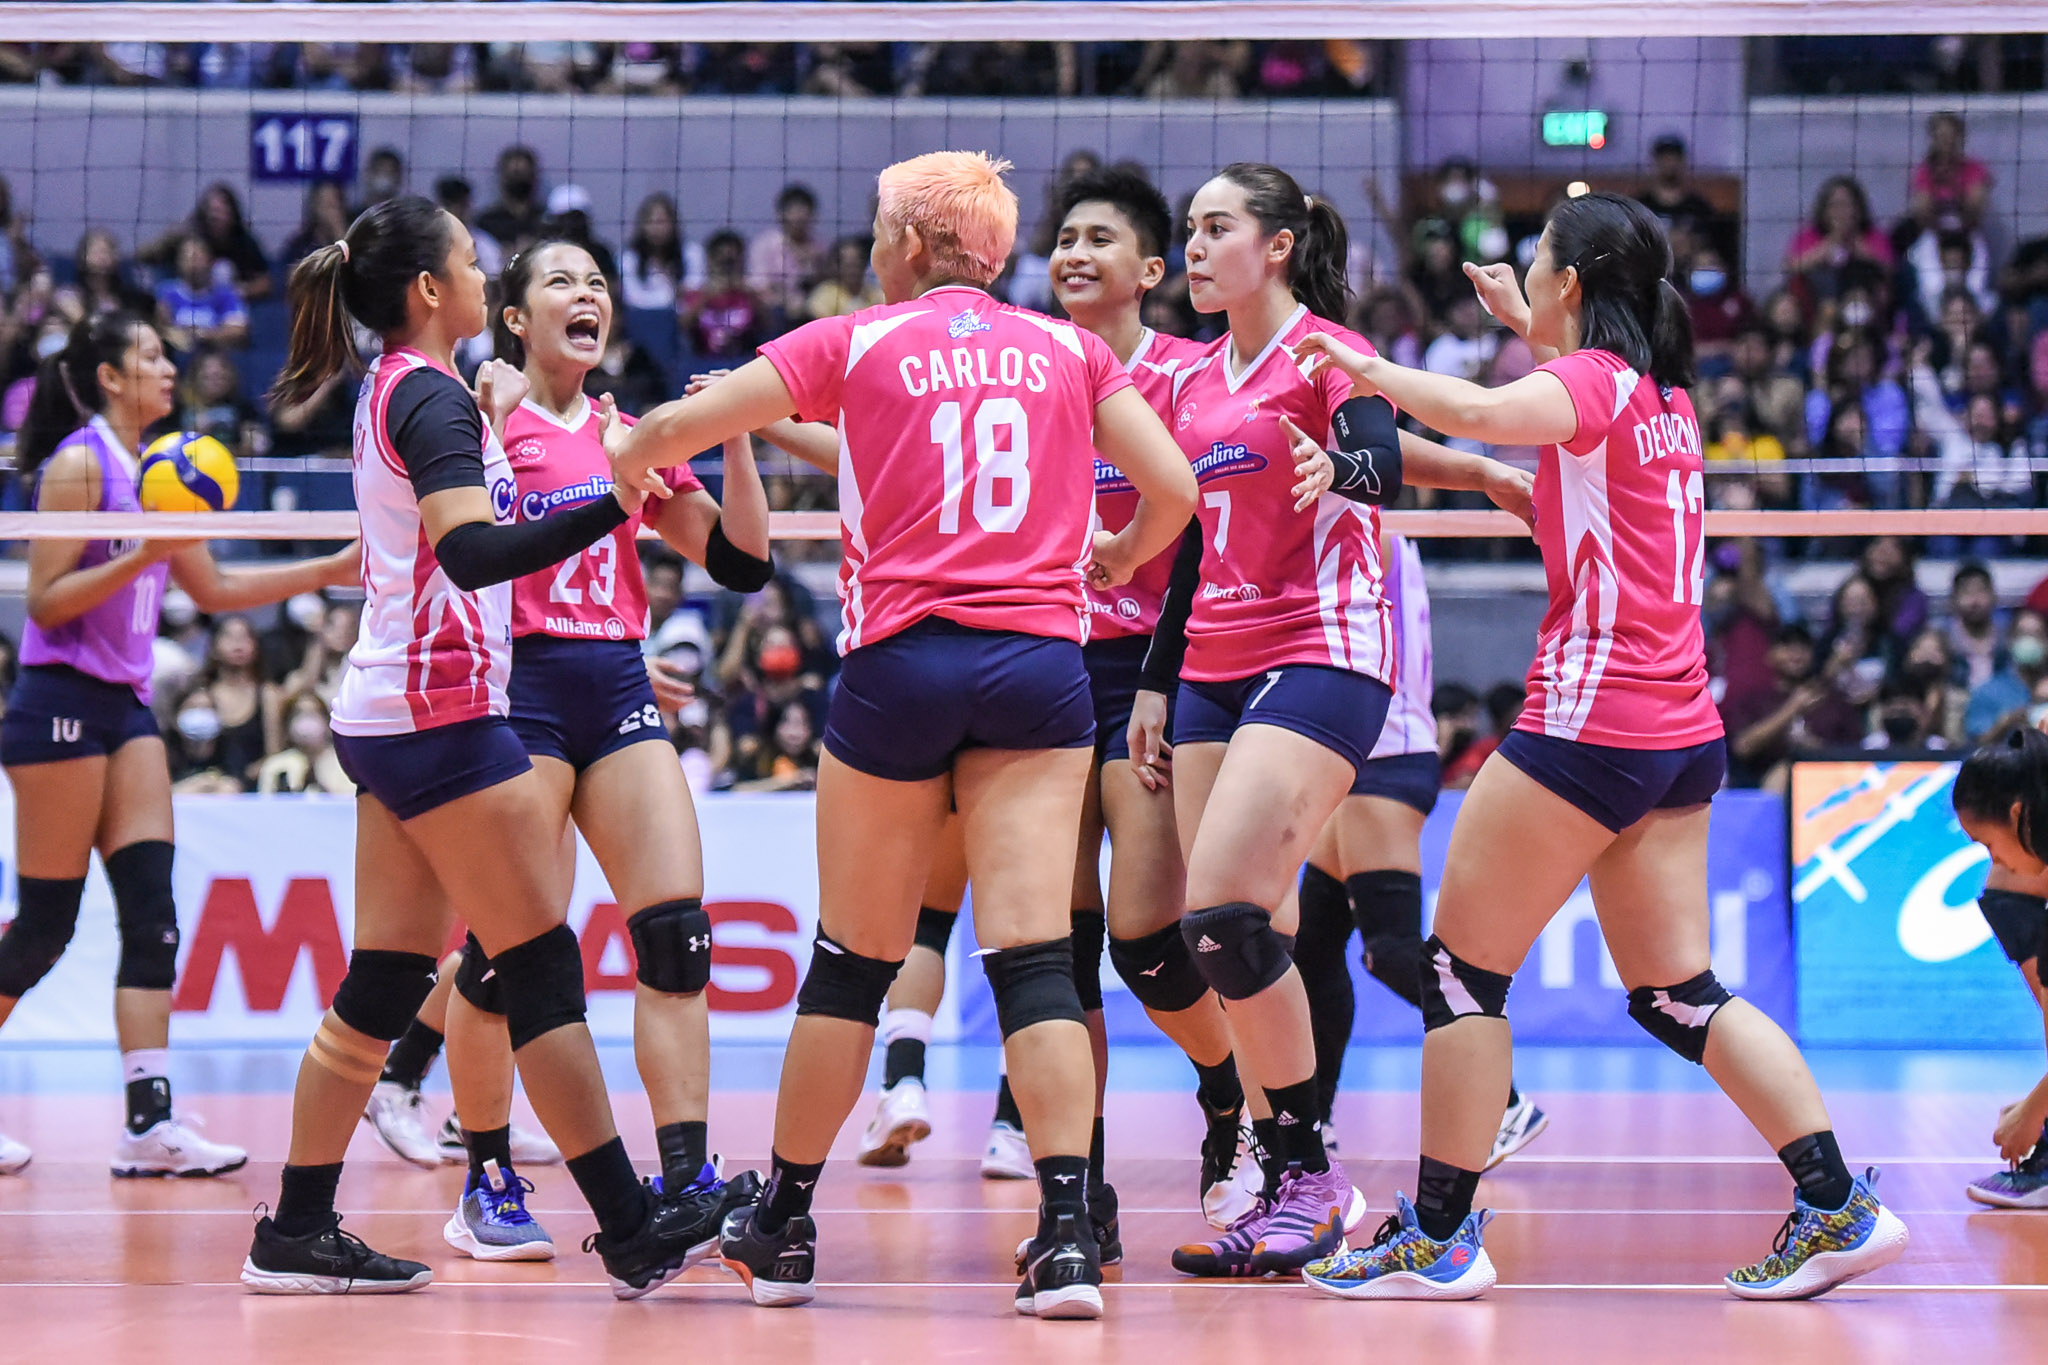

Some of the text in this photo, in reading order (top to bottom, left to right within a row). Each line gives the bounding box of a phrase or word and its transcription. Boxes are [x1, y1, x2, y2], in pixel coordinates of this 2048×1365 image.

[254, 119, 350, 171] 117
[898, 346, 1050, 397] CARLOS
[930, 397, 1031, 534] 18
[1202, 490, 1232, 563] 7
[1665, 469, 1704, 606] 12
[549, 533, 617, 607] 23
[132, 574, 156, 635] 10
[545, 617, 605, 636] Allianz
[1249, 671, 1284, 710] 7
